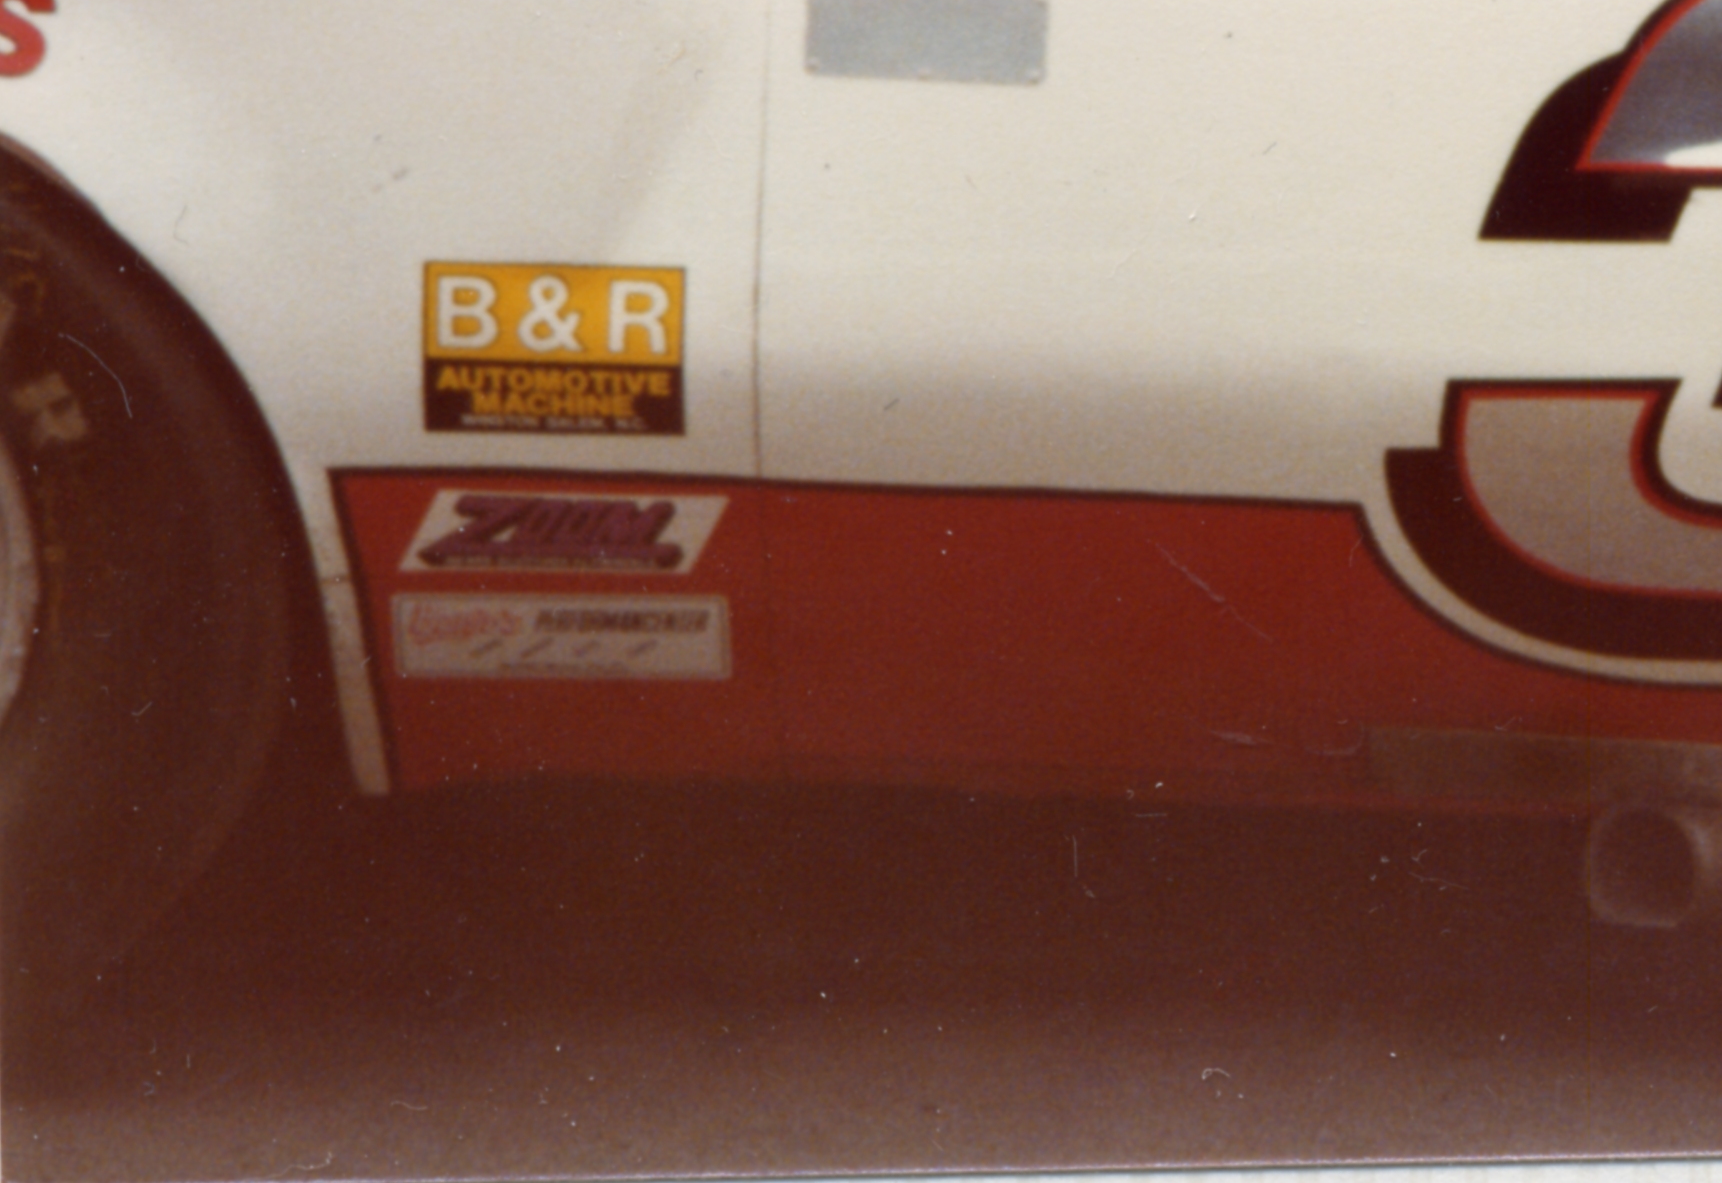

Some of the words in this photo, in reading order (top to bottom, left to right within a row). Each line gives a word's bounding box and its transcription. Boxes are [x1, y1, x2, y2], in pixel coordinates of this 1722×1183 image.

[436, 275, 498, 349] B
[517, 274, 584, 353] &
[607, 279, 670, 355] R
[436, 366, 671, 397] AUTOMOTIVE
[472, 391, 636, 417] MACHINE
